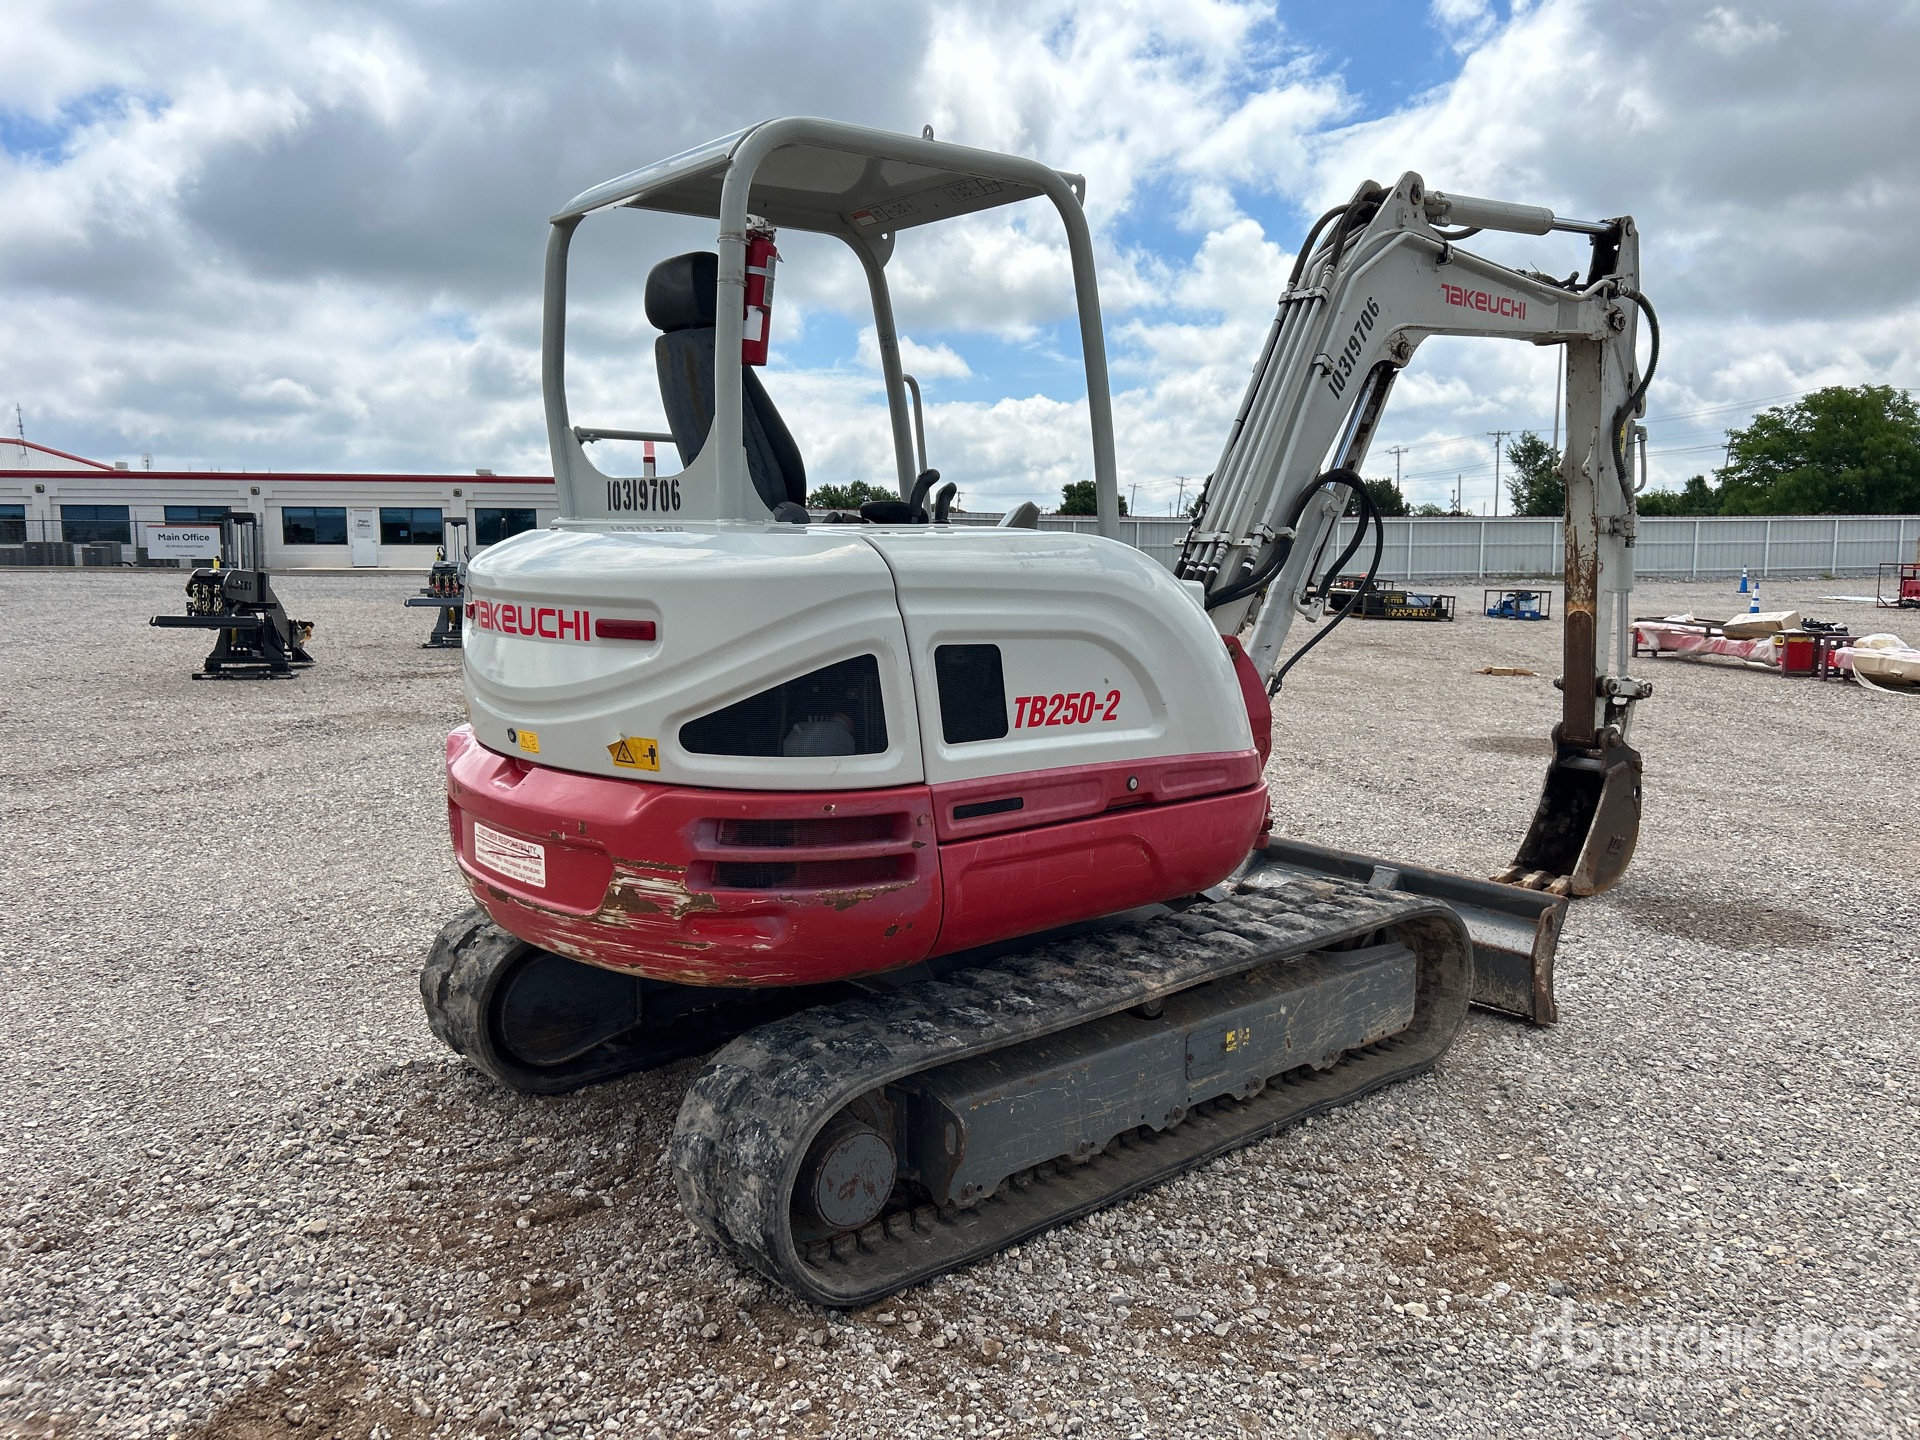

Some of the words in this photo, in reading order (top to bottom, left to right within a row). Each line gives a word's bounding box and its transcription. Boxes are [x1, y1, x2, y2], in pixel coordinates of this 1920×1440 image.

[1441, 283, 1526, 320] TAKEUCHI
[1328, 296, 1380, 400] 10319706
[607, 479, 681, 512] 10319706
[157, 533, 180, 541] Main
[182, 533, 210, 541] Office
[1014, 689, 1121, 729] TB250-2
